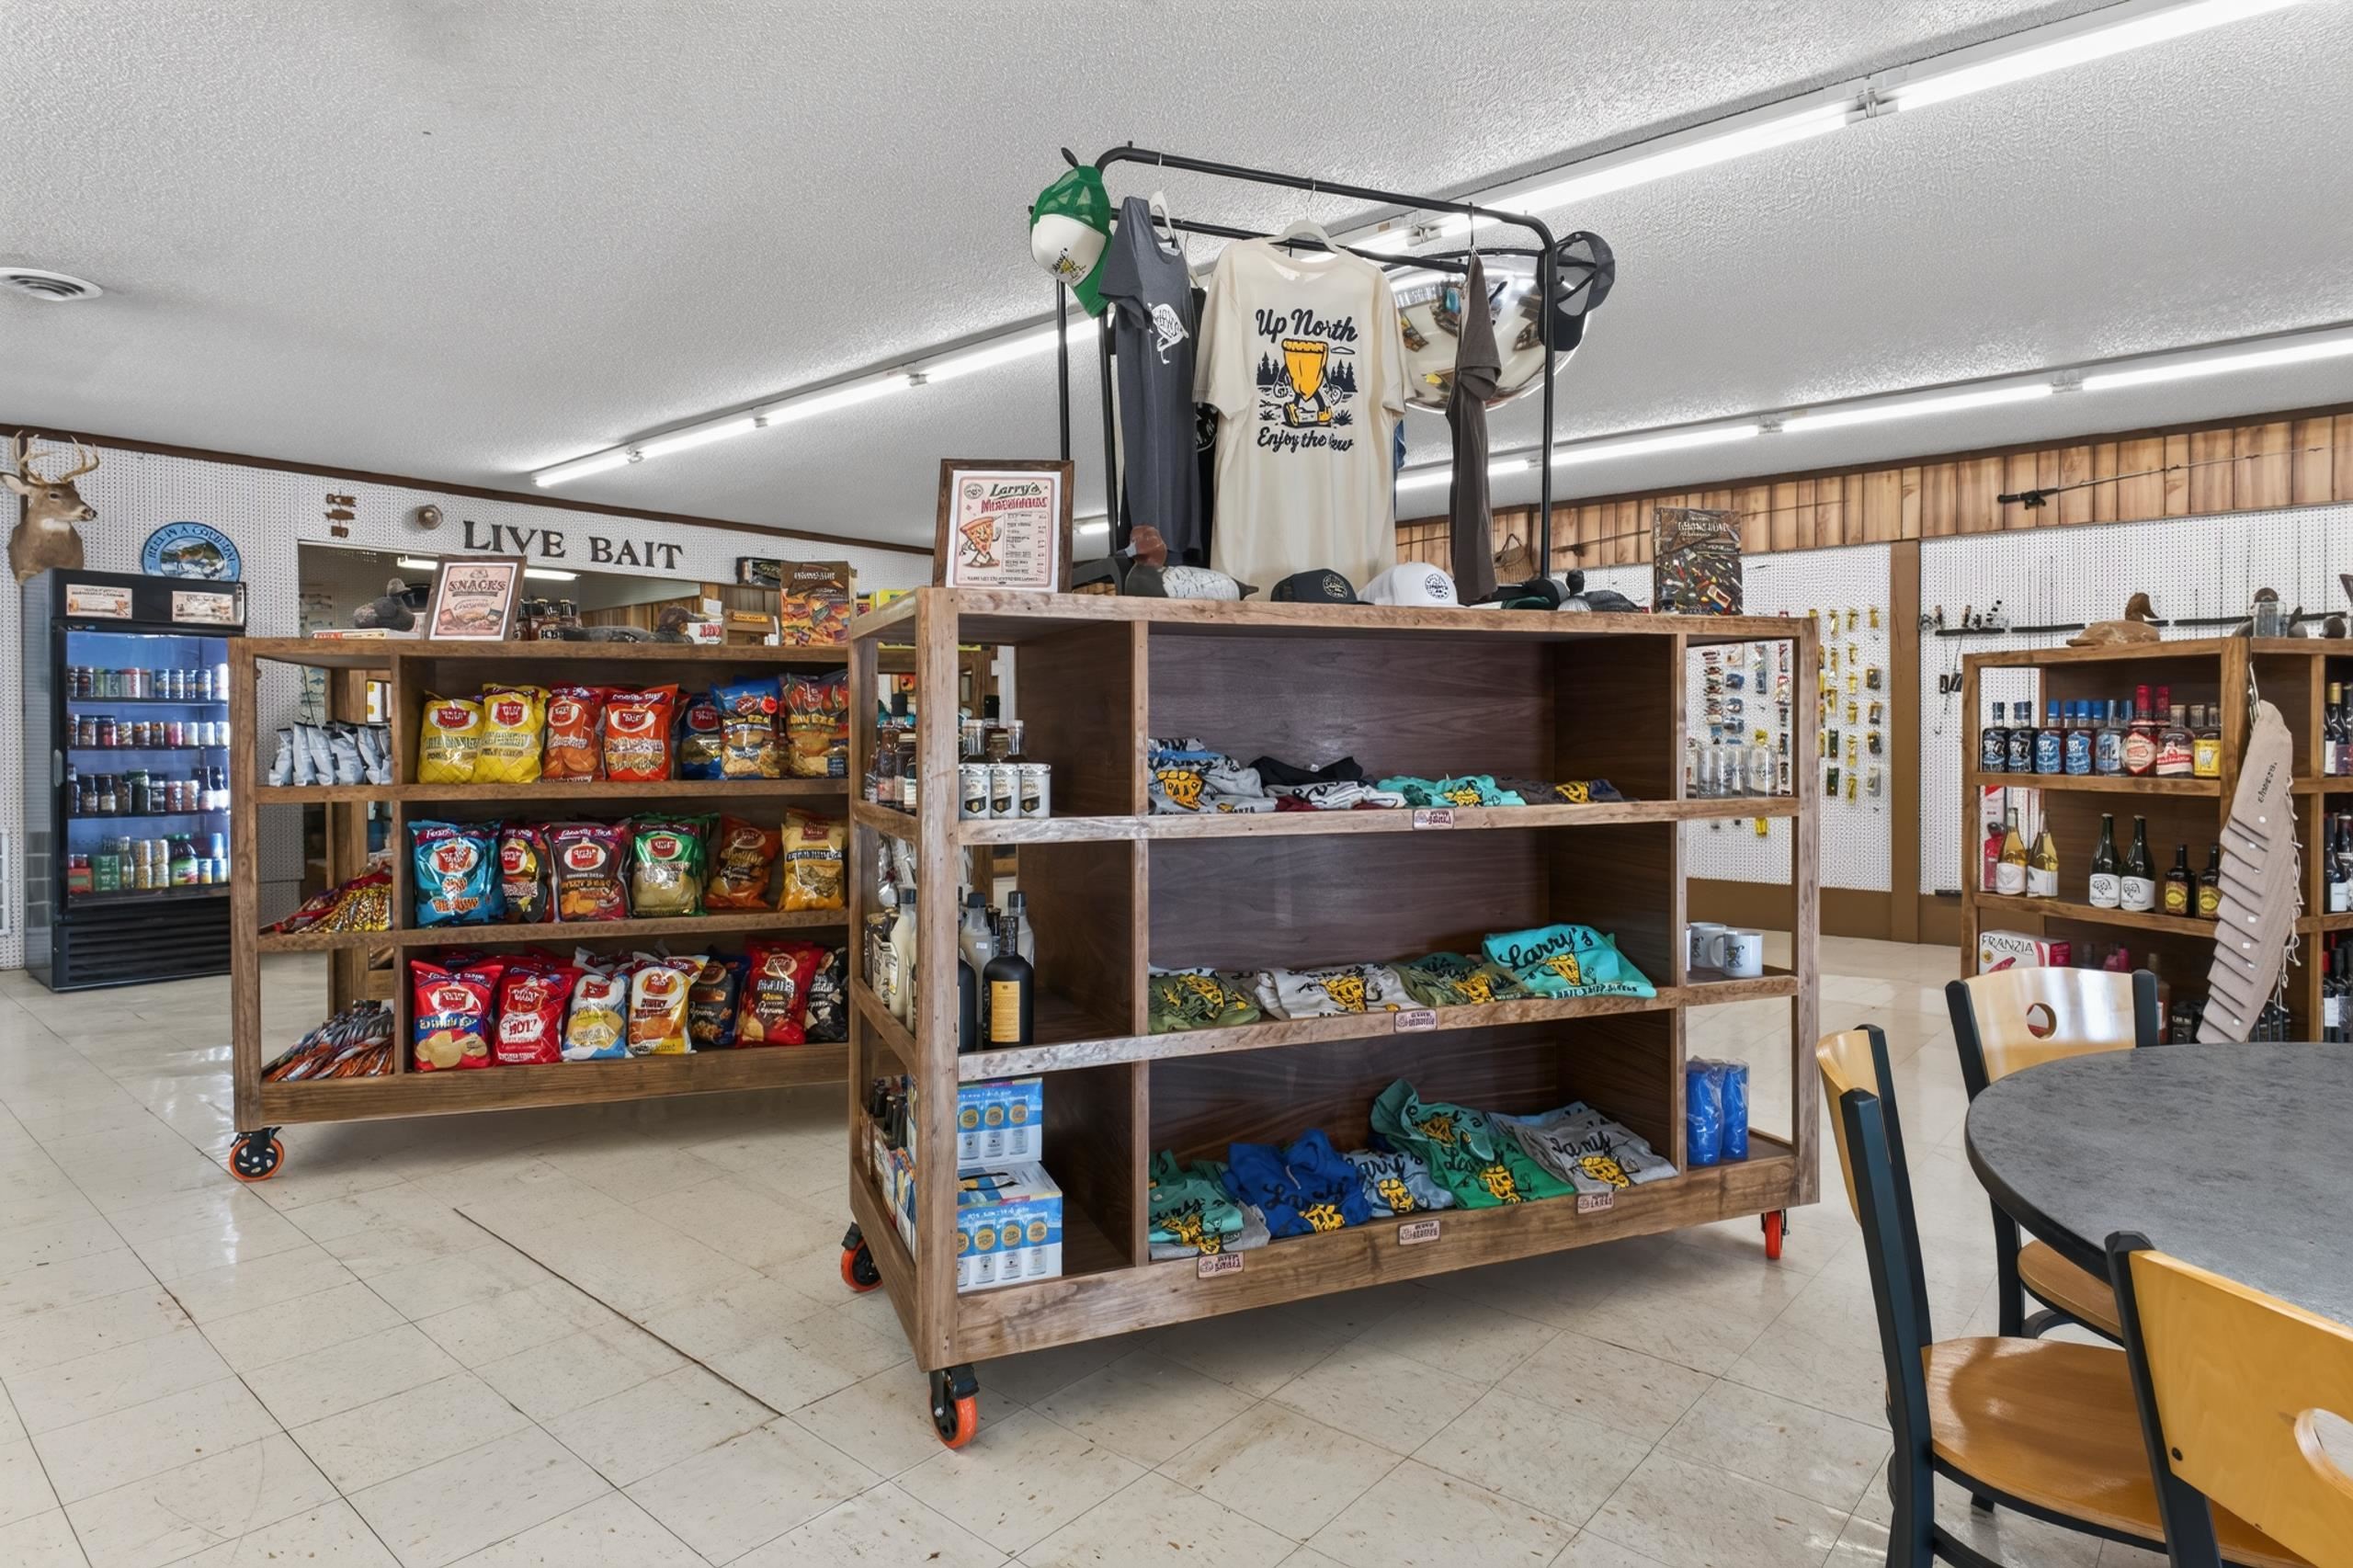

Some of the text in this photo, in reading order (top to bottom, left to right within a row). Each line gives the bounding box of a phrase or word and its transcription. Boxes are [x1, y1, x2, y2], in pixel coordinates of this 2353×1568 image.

[1256, 308, 1358, 344] Up North
[1256, 426, 1300, 453] Enjoy
[1301, 430, 1327, 448] the
[989, 482, 1042, 498] Larry's
[463, 520, 683, 570] LIVE BAIT
[448, 579, 507, 592] SNACKS
[1497, 927, 1594, 971] Larry's
[1982, 935, 2035, 956] FRANZIA
